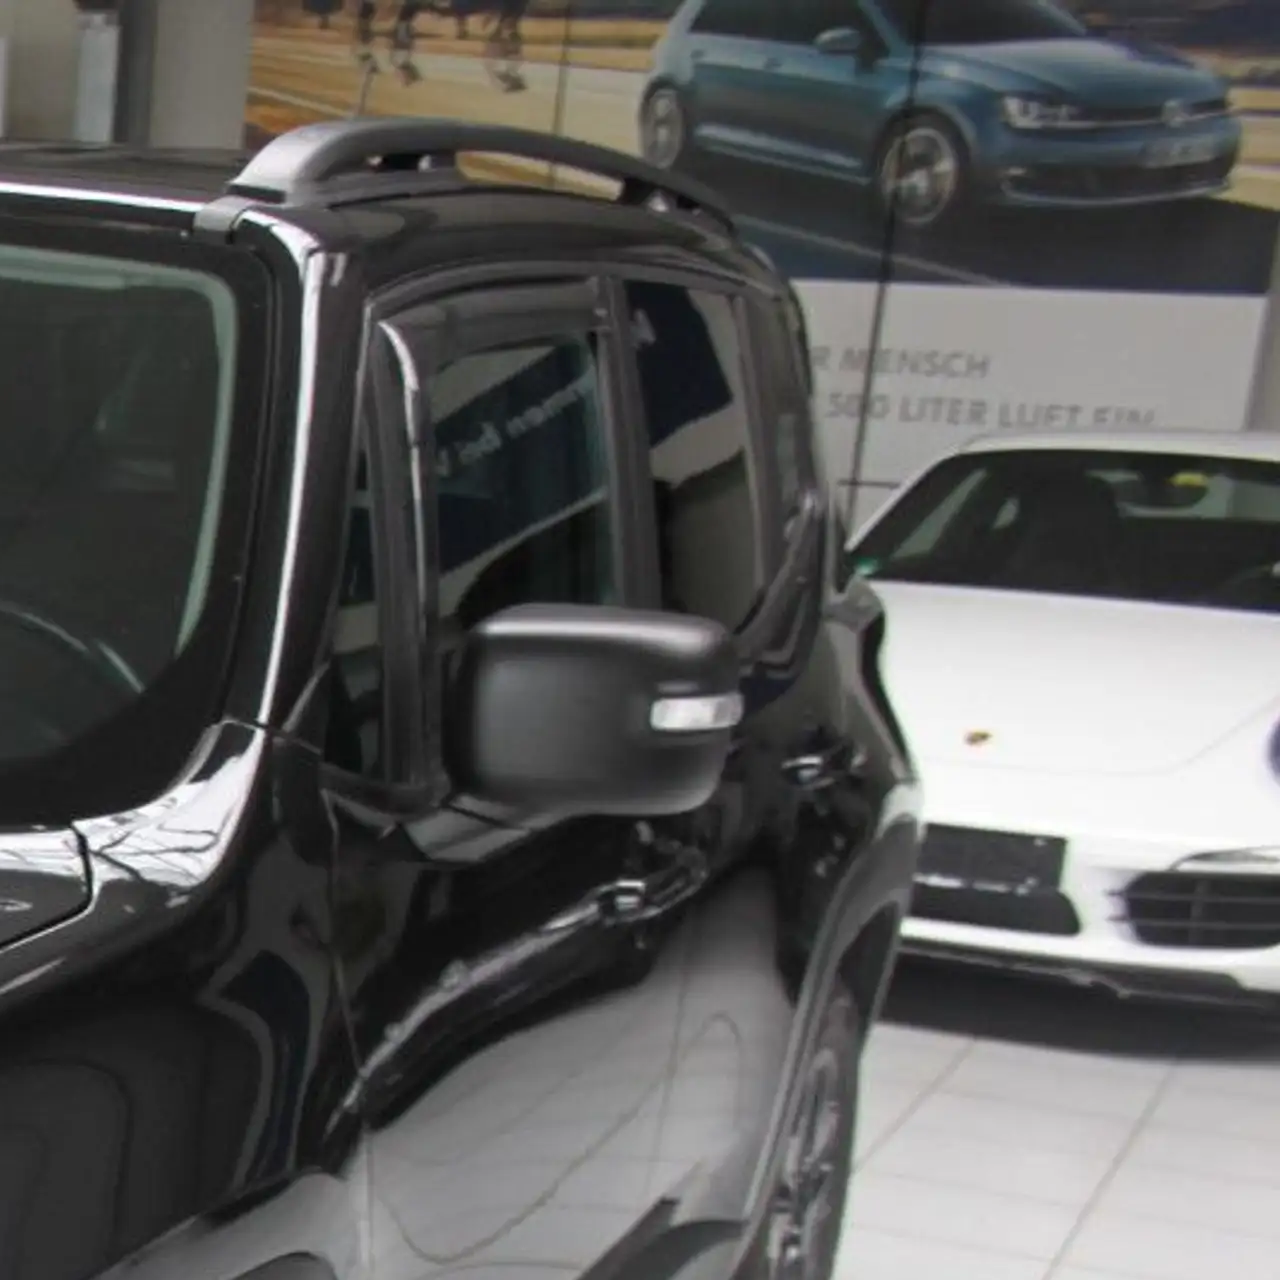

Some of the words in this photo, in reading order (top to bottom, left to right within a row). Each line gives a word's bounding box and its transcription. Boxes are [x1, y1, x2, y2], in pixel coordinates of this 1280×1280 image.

[839, 347, 991, 378] MENSCH
[899, 394, 987, 427] LITER
[998, 402, 1083, 429] LUFT
